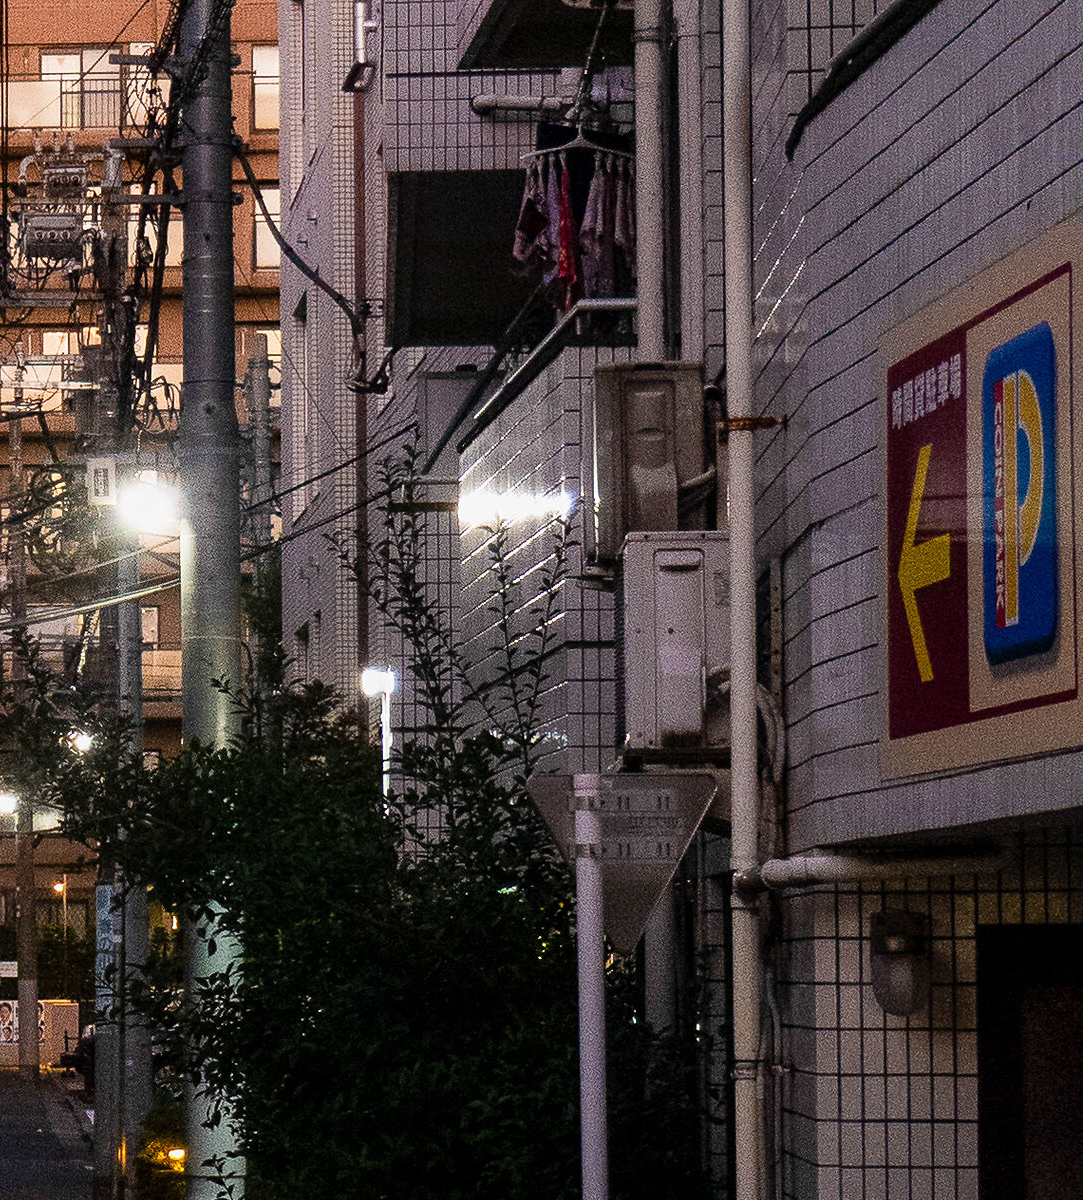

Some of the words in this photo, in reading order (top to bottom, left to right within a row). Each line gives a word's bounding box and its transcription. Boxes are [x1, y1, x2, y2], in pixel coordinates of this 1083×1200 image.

[892, 352, 961, 430] 時間貸駐車場
[995, 401, 1004, 498] COIN
[1003, 371, 1044, 627] P
[995, 511, 1005, 609] PARK
